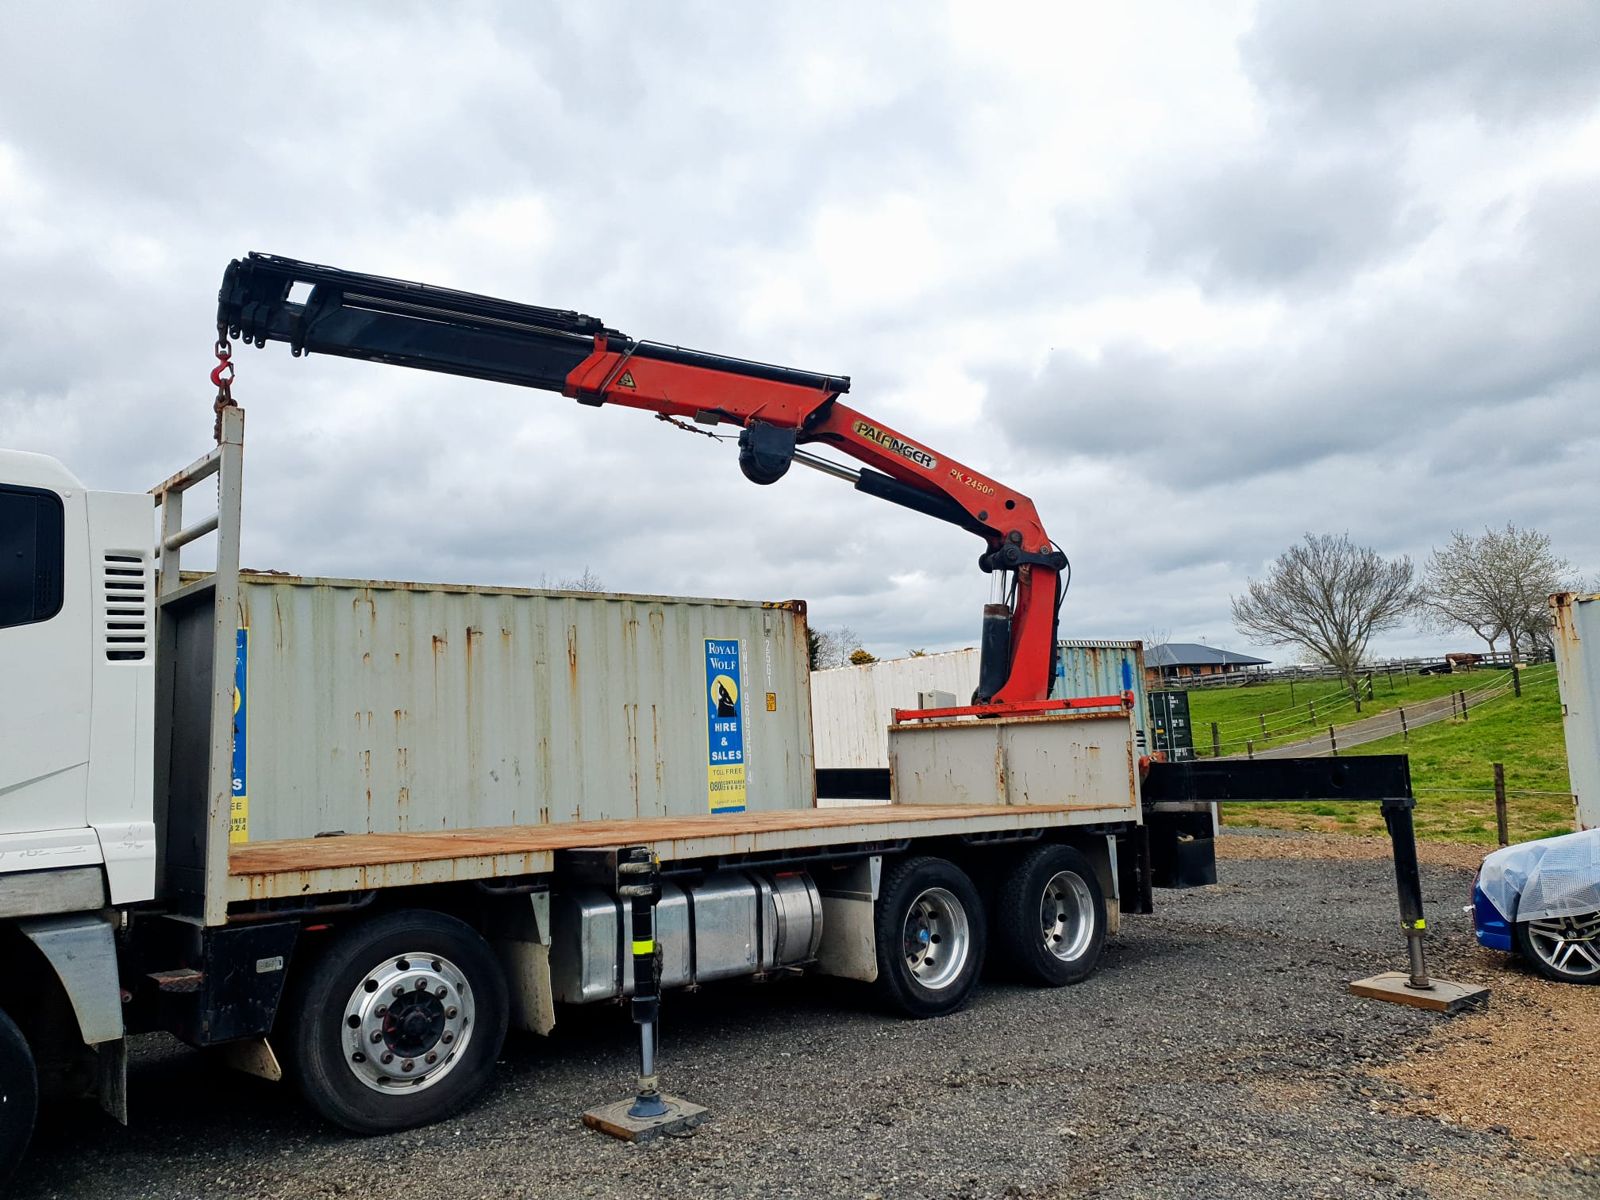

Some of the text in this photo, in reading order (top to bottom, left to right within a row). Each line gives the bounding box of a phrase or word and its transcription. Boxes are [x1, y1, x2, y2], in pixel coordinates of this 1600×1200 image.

[857, 422, 932, 467] PALFINGER
[965, 476, 995, 496] 24500
[708, 642, 737, 655] ROYAL
[710, 657, 737, 670] WOLF
[715, 722, 737, 732] HIRE
[720, 737, 728, 746] &
[711, 751, 742, 761] SALES
[725, 767, 742, 775] FREE
